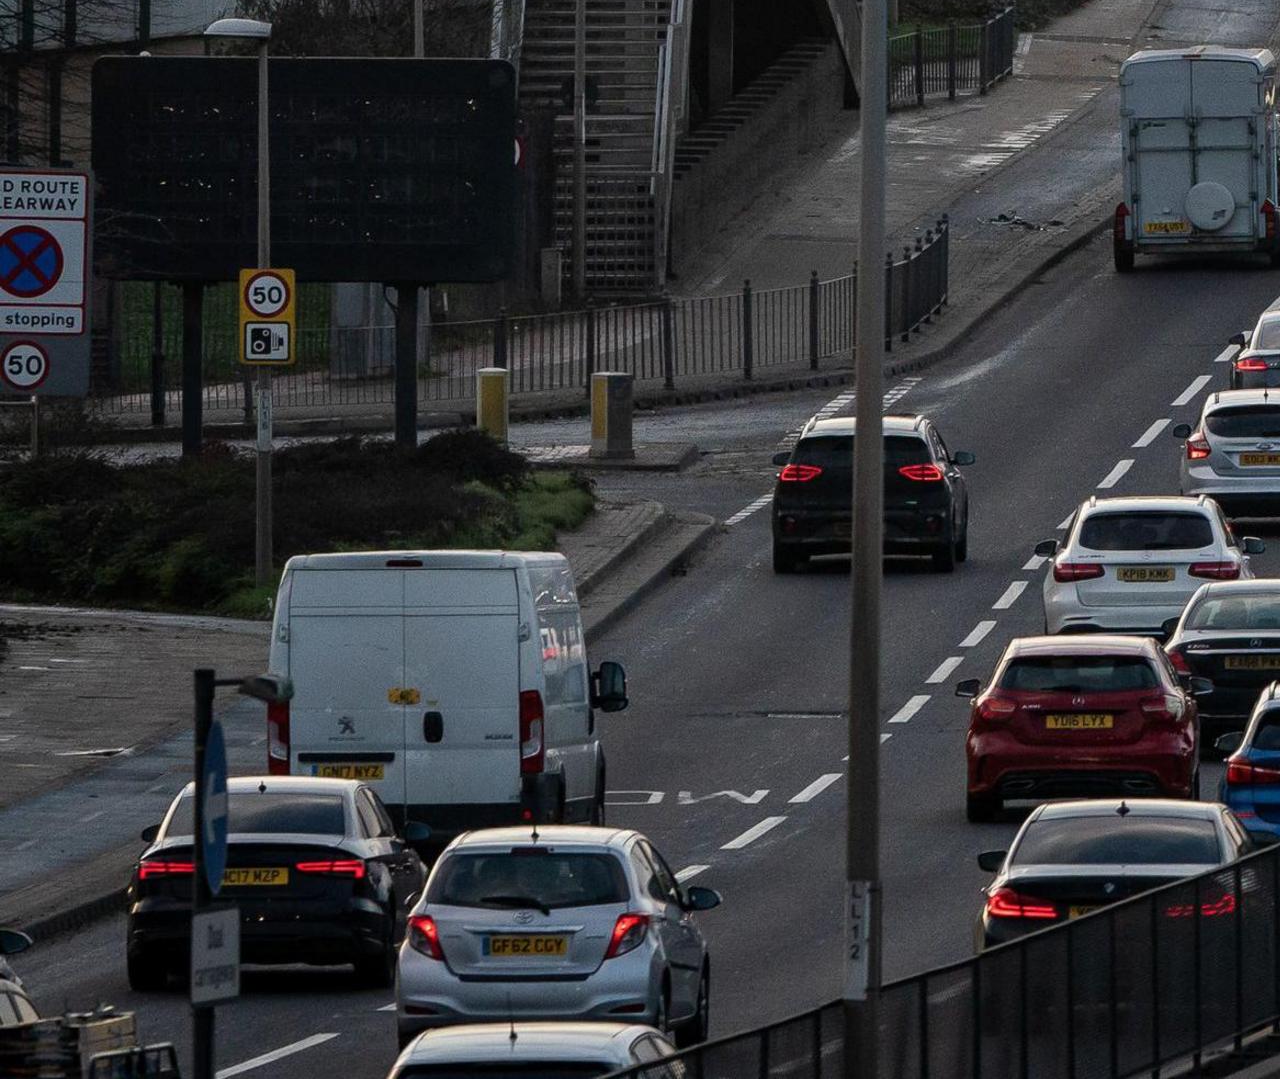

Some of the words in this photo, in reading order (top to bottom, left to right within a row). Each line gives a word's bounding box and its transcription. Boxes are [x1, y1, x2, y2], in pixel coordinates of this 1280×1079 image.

[20, 180, 80, 194] ROUTE
[252, 286, 283, 306] 50
[6, 312, 76, 328] stopping
[8, 354, 43, 376] 50
[492, 938, 531, 954] GF62
[534, 937, 564, 953] CGY
